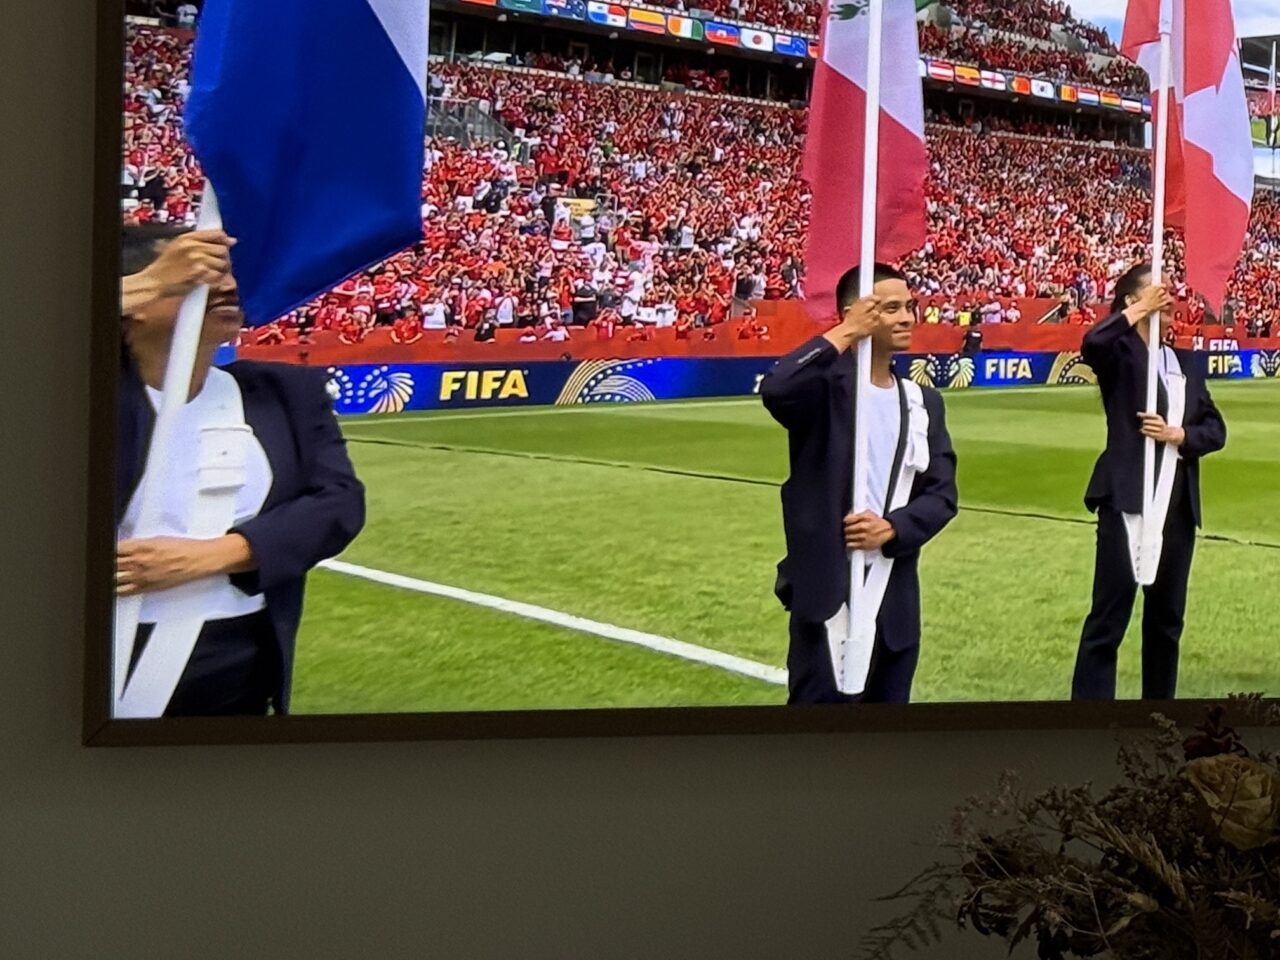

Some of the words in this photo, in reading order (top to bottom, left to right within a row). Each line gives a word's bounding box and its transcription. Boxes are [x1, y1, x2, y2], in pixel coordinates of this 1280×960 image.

[985, 358, 1032, 379] FIFA
[1208, 355, 1242, 374] FIFA
[439, 369, 528, 401] FIFA
